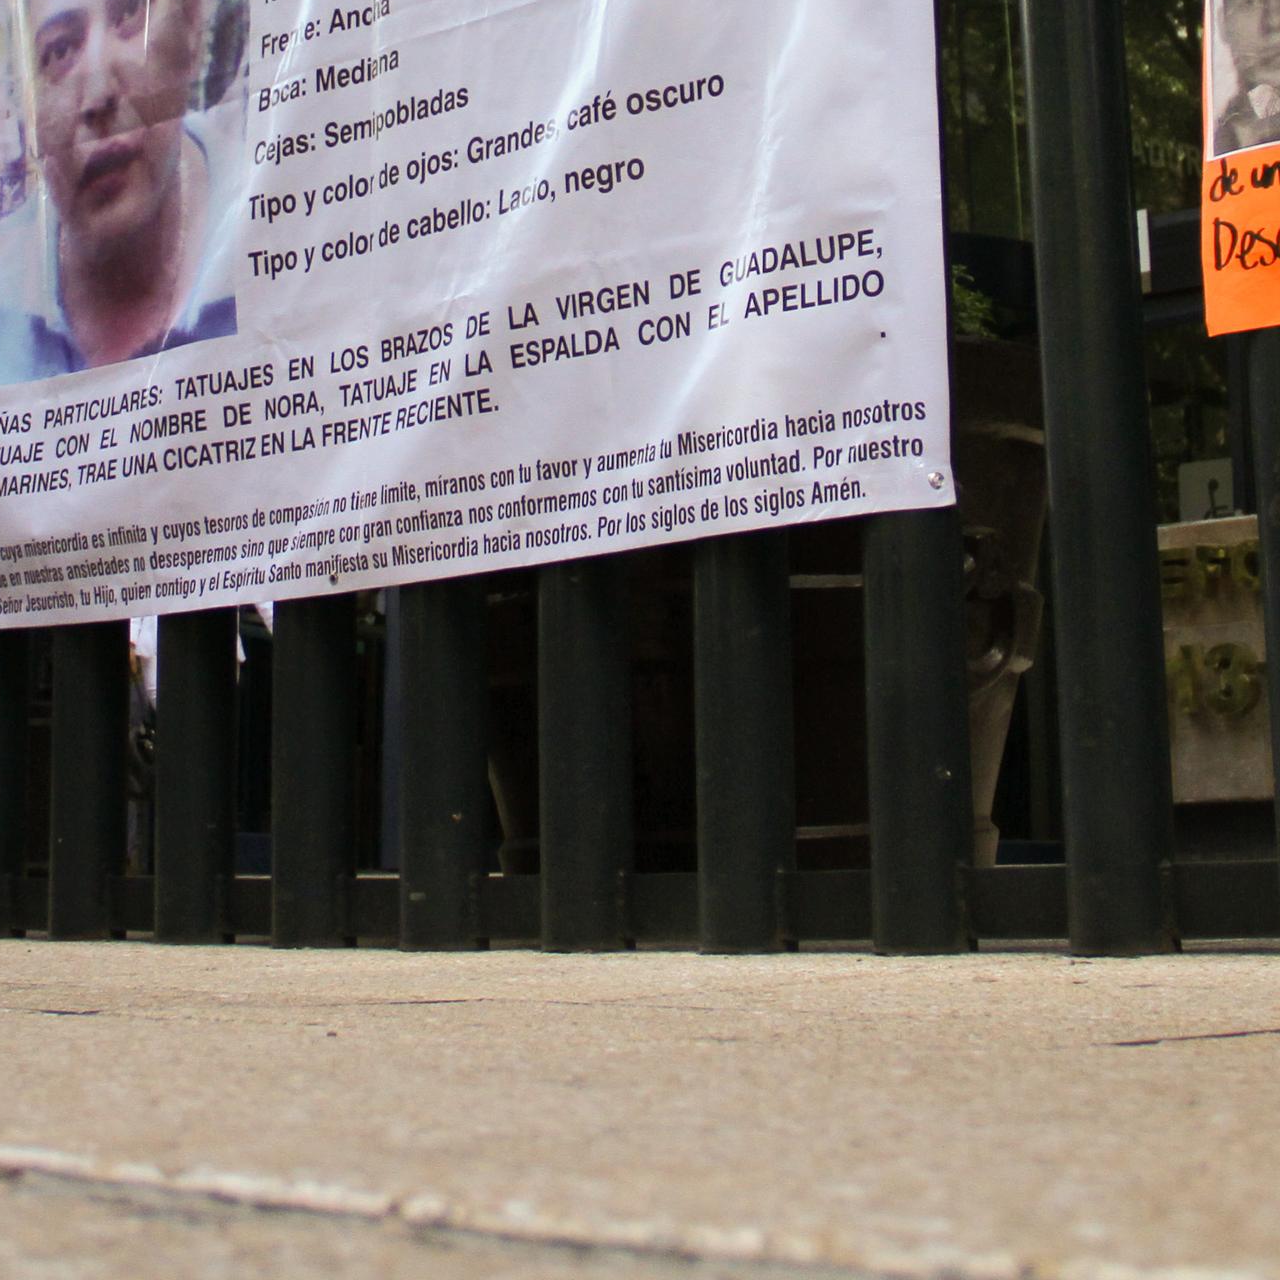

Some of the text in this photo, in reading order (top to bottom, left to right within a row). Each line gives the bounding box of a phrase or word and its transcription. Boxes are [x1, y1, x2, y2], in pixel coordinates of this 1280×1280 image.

[255, 87, 468, 165] Cejas: Semipobladas
[259, 48, 399, 112] Boca: Mediana
[249, 72, 725, 222] Tipo y color de ojos: café oscuro
[1209, 160, 1244, 202] de
[249, 159, 645, 279] Tipo y color de cabello: Lacio, negro
[44, 386, 162, 429] PARTICULARES:
[175, 363, 273, 400] TATUAJES
[289, 356, 314, 380] EN
[330, 346, 369, 373] LOS
[381, 323, 452, 362] BRAZOS
[466, 312, 490, 339] DE
[507, 303, 539, 330] LA
[556, 281, 650, 319] VIRGEN
[670, 271, 700, 299] DE
[720, 230, 882, 287] GUADALUPE,
[130, 271, 884, 443] NOMBRE NORA, TATUAJE ESPALDA APELLIDO
[24, 401, 926, 558] misericordia infinita compasión míranos Misericordia hacia nosotros
[78, 460, 117, 485] TRAE
[123, 452, 158, 477] UNA
[163, 436, 256, 472] CICATRIZ
[322, 411, 392, 446] FRENTE
[396, 389, 498, 431] RECIENTE.
[396, 507, 463, 534] confianza
[726, 451, 806, 483] voluntad.
[813, 445, 842, 470] Por
[848, 437, 923, 464] nuestro
[269, 476, 865, 583] Santo Misericordia nosotros. siglos Amén.
